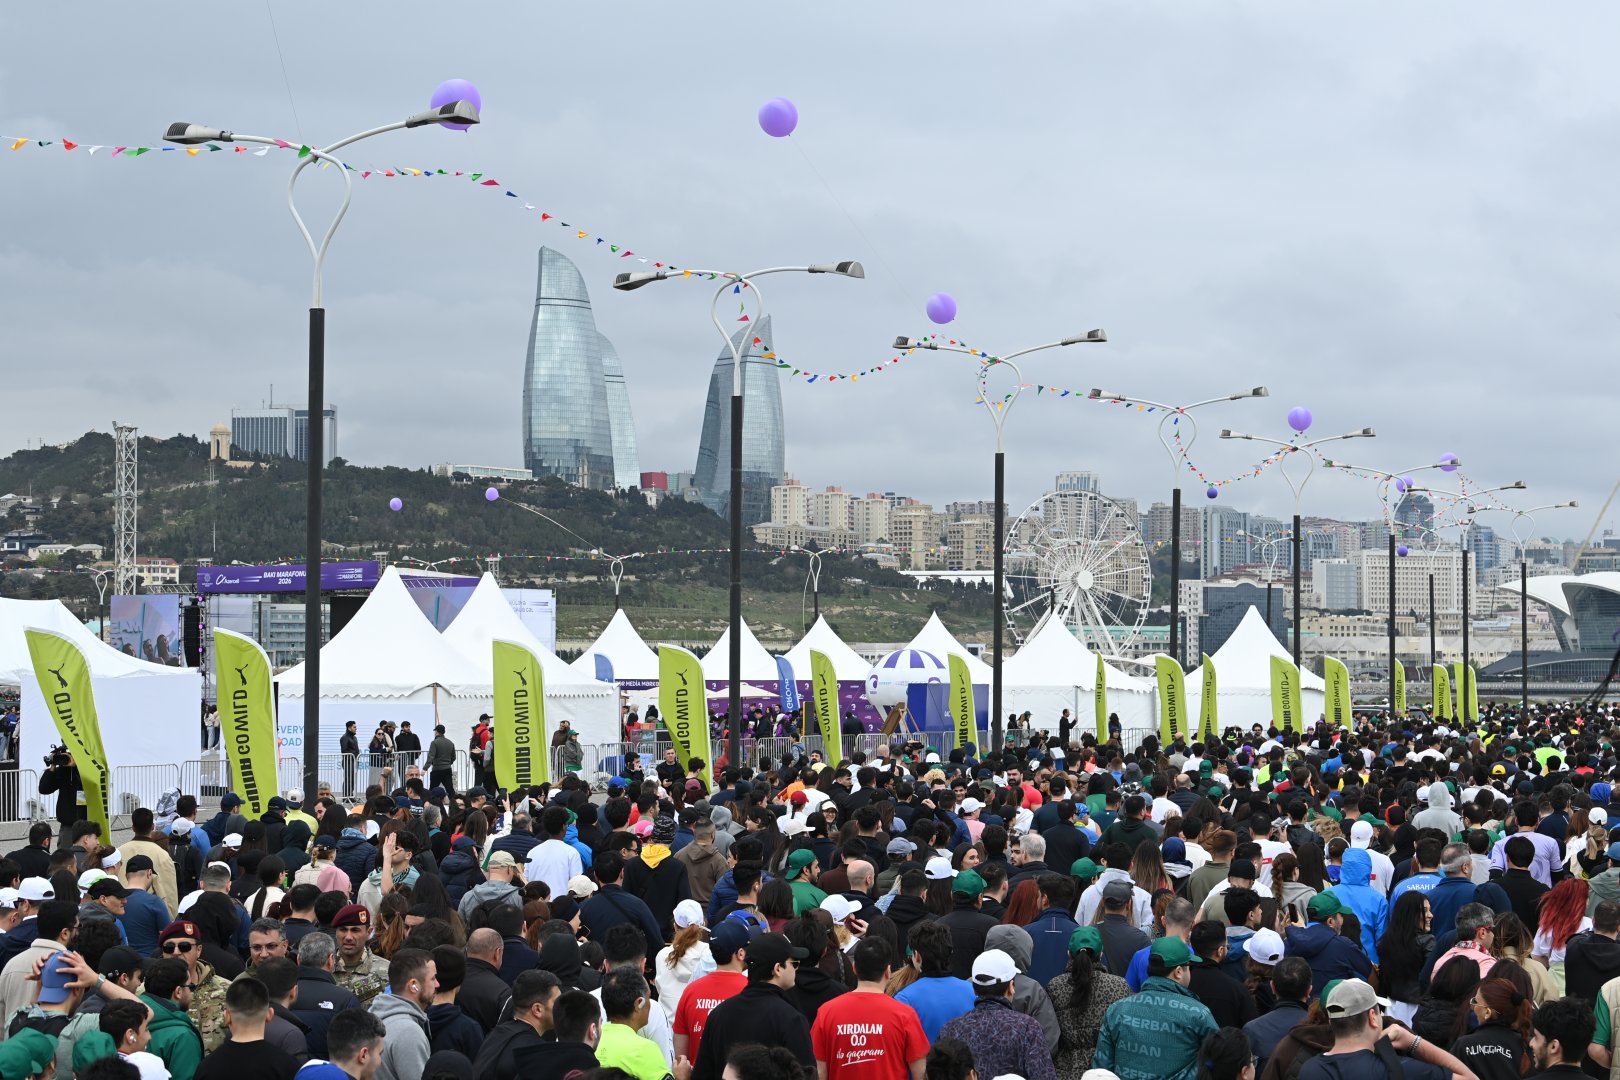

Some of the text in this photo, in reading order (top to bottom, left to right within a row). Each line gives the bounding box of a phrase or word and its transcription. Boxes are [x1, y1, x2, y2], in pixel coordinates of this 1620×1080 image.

[282, 737, 302, 746] OAD
[696, 998, 724, 1008] XIRD
[1120, 994, 1165, 1006] AIJAN
[837, 1024, 883, 1035] XIRDALAN
[850, 1035, 866, 1046] 0.0
